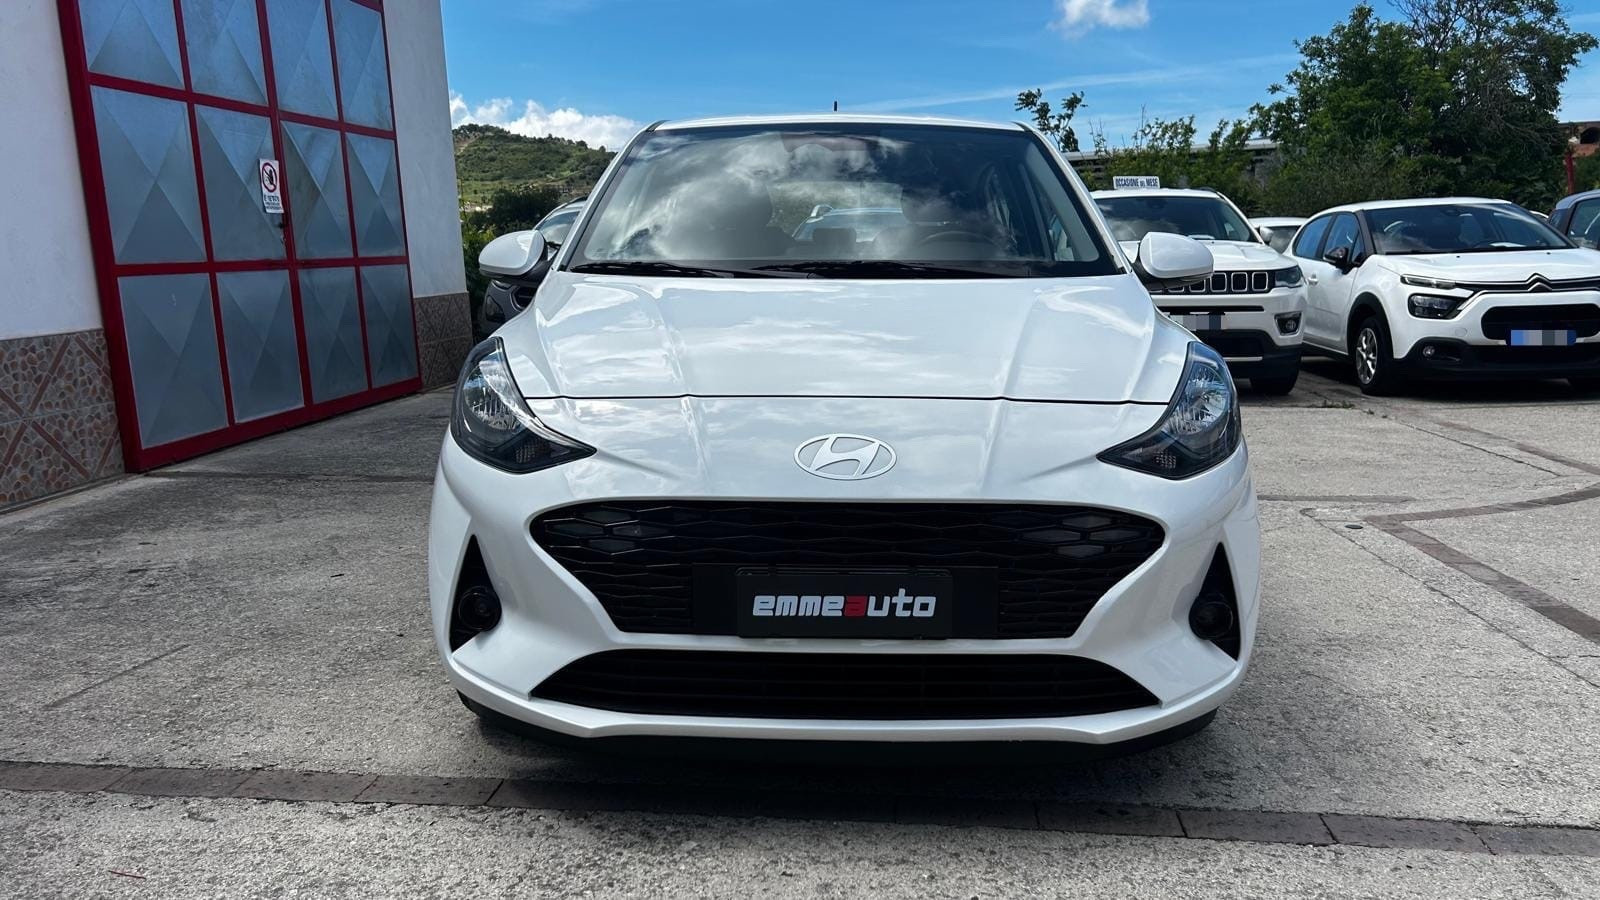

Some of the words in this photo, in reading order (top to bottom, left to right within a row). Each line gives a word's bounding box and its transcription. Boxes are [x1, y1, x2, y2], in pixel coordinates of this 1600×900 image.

[1115, 178, 1139, 187] OCCASIONE
[1146, 178, 1159, 187] MESE
[753, 588, 936, 617] emmeauto
